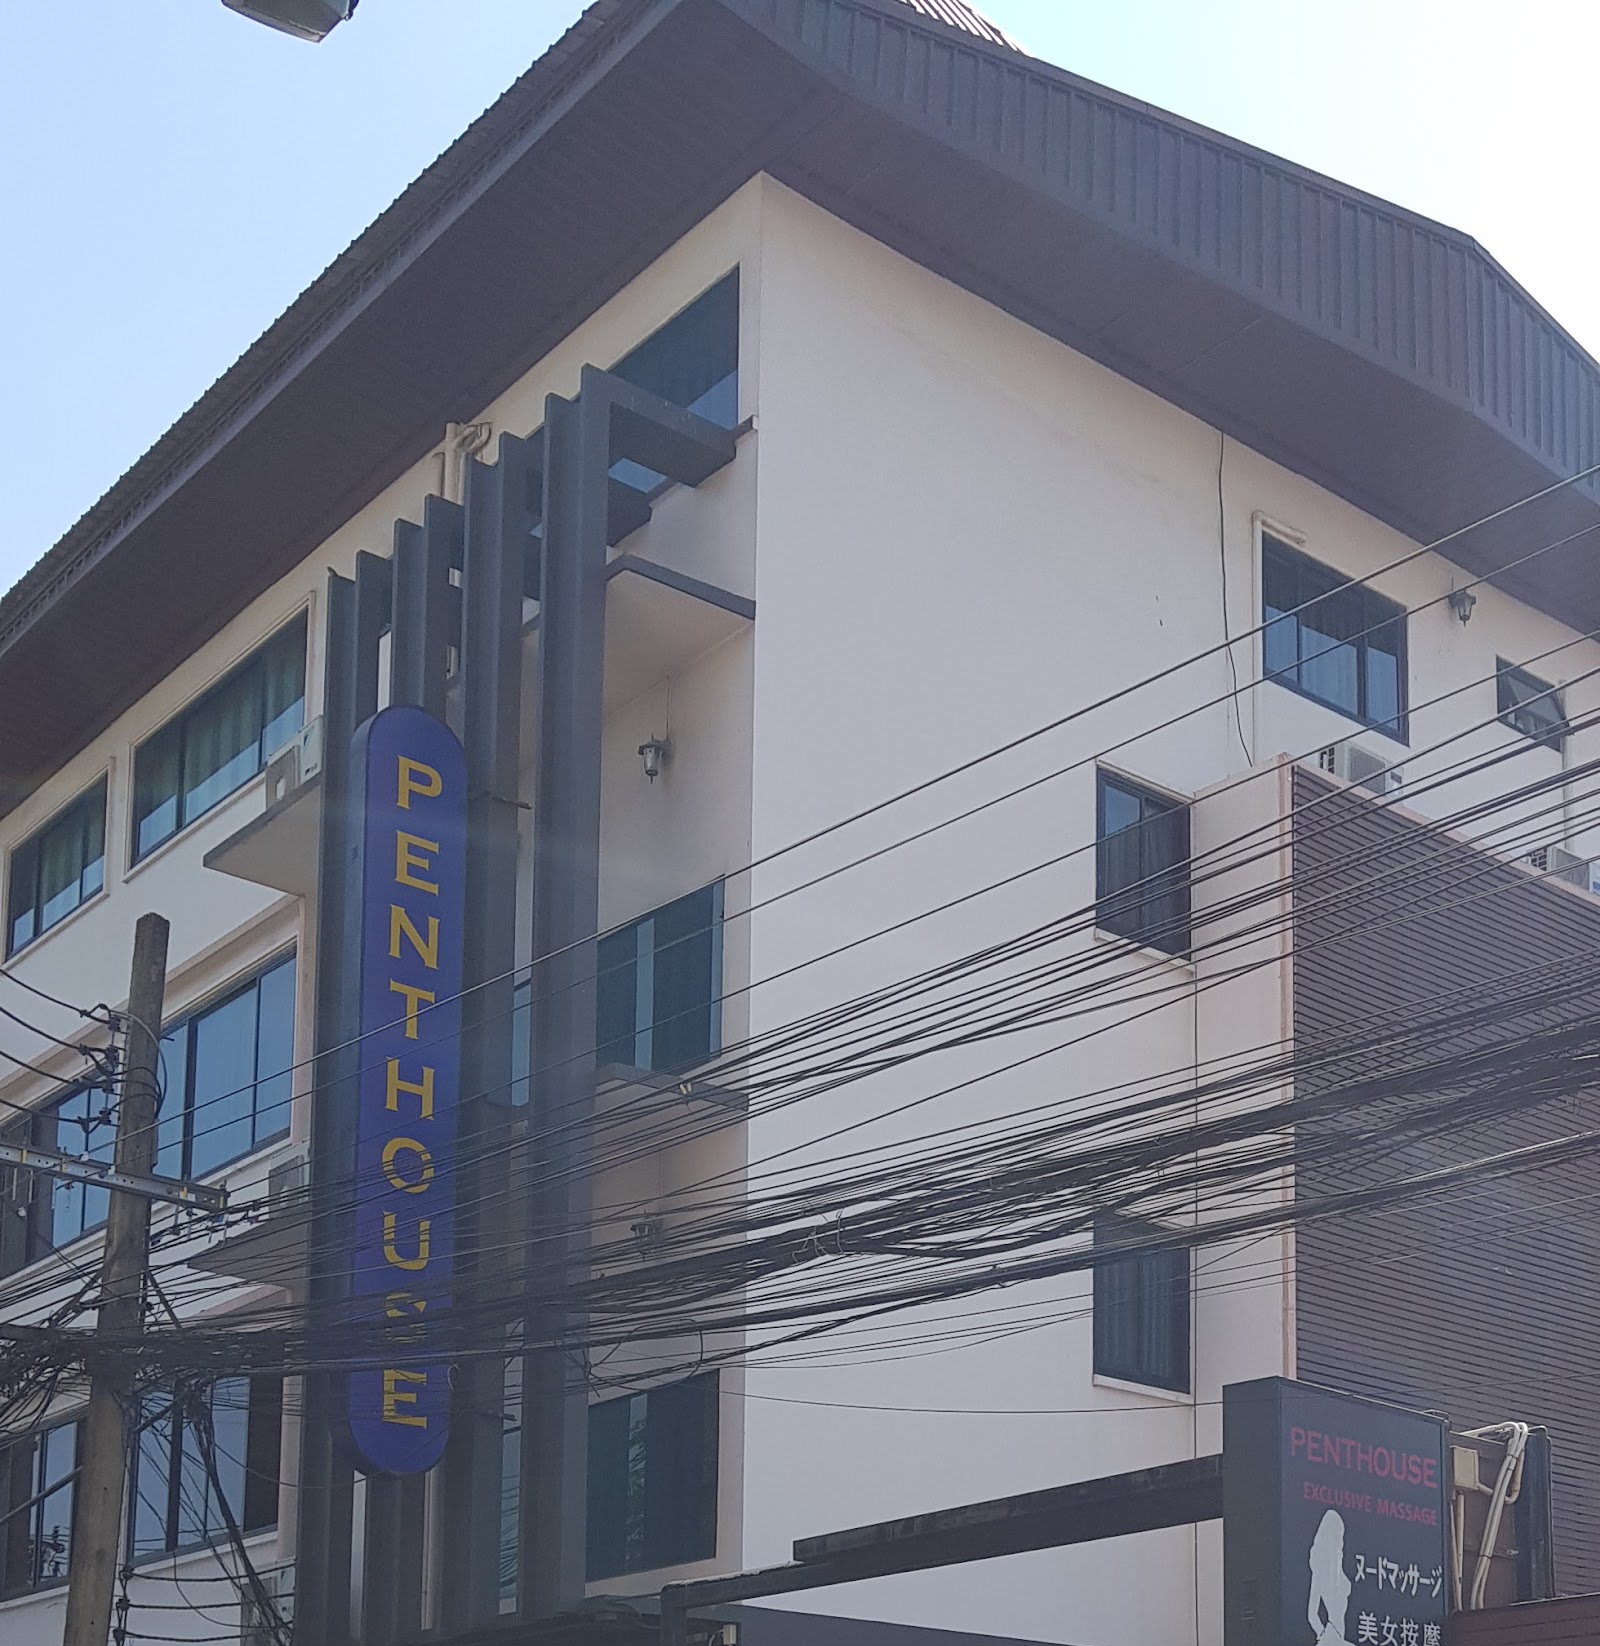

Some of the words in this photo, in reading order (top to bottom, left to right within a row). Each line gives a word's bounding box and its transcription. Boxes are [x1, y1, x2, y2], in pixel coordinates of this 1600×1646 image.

[1289, 1426, 1438, 1489] PENTHOUSE
[1303, 1480, 1372, 1513] EXCLUSIVE
[1376, 1498, 1437, 1526] MASSAGE
[1354, 1554, 1443, 1598] ヌードマッサージ
